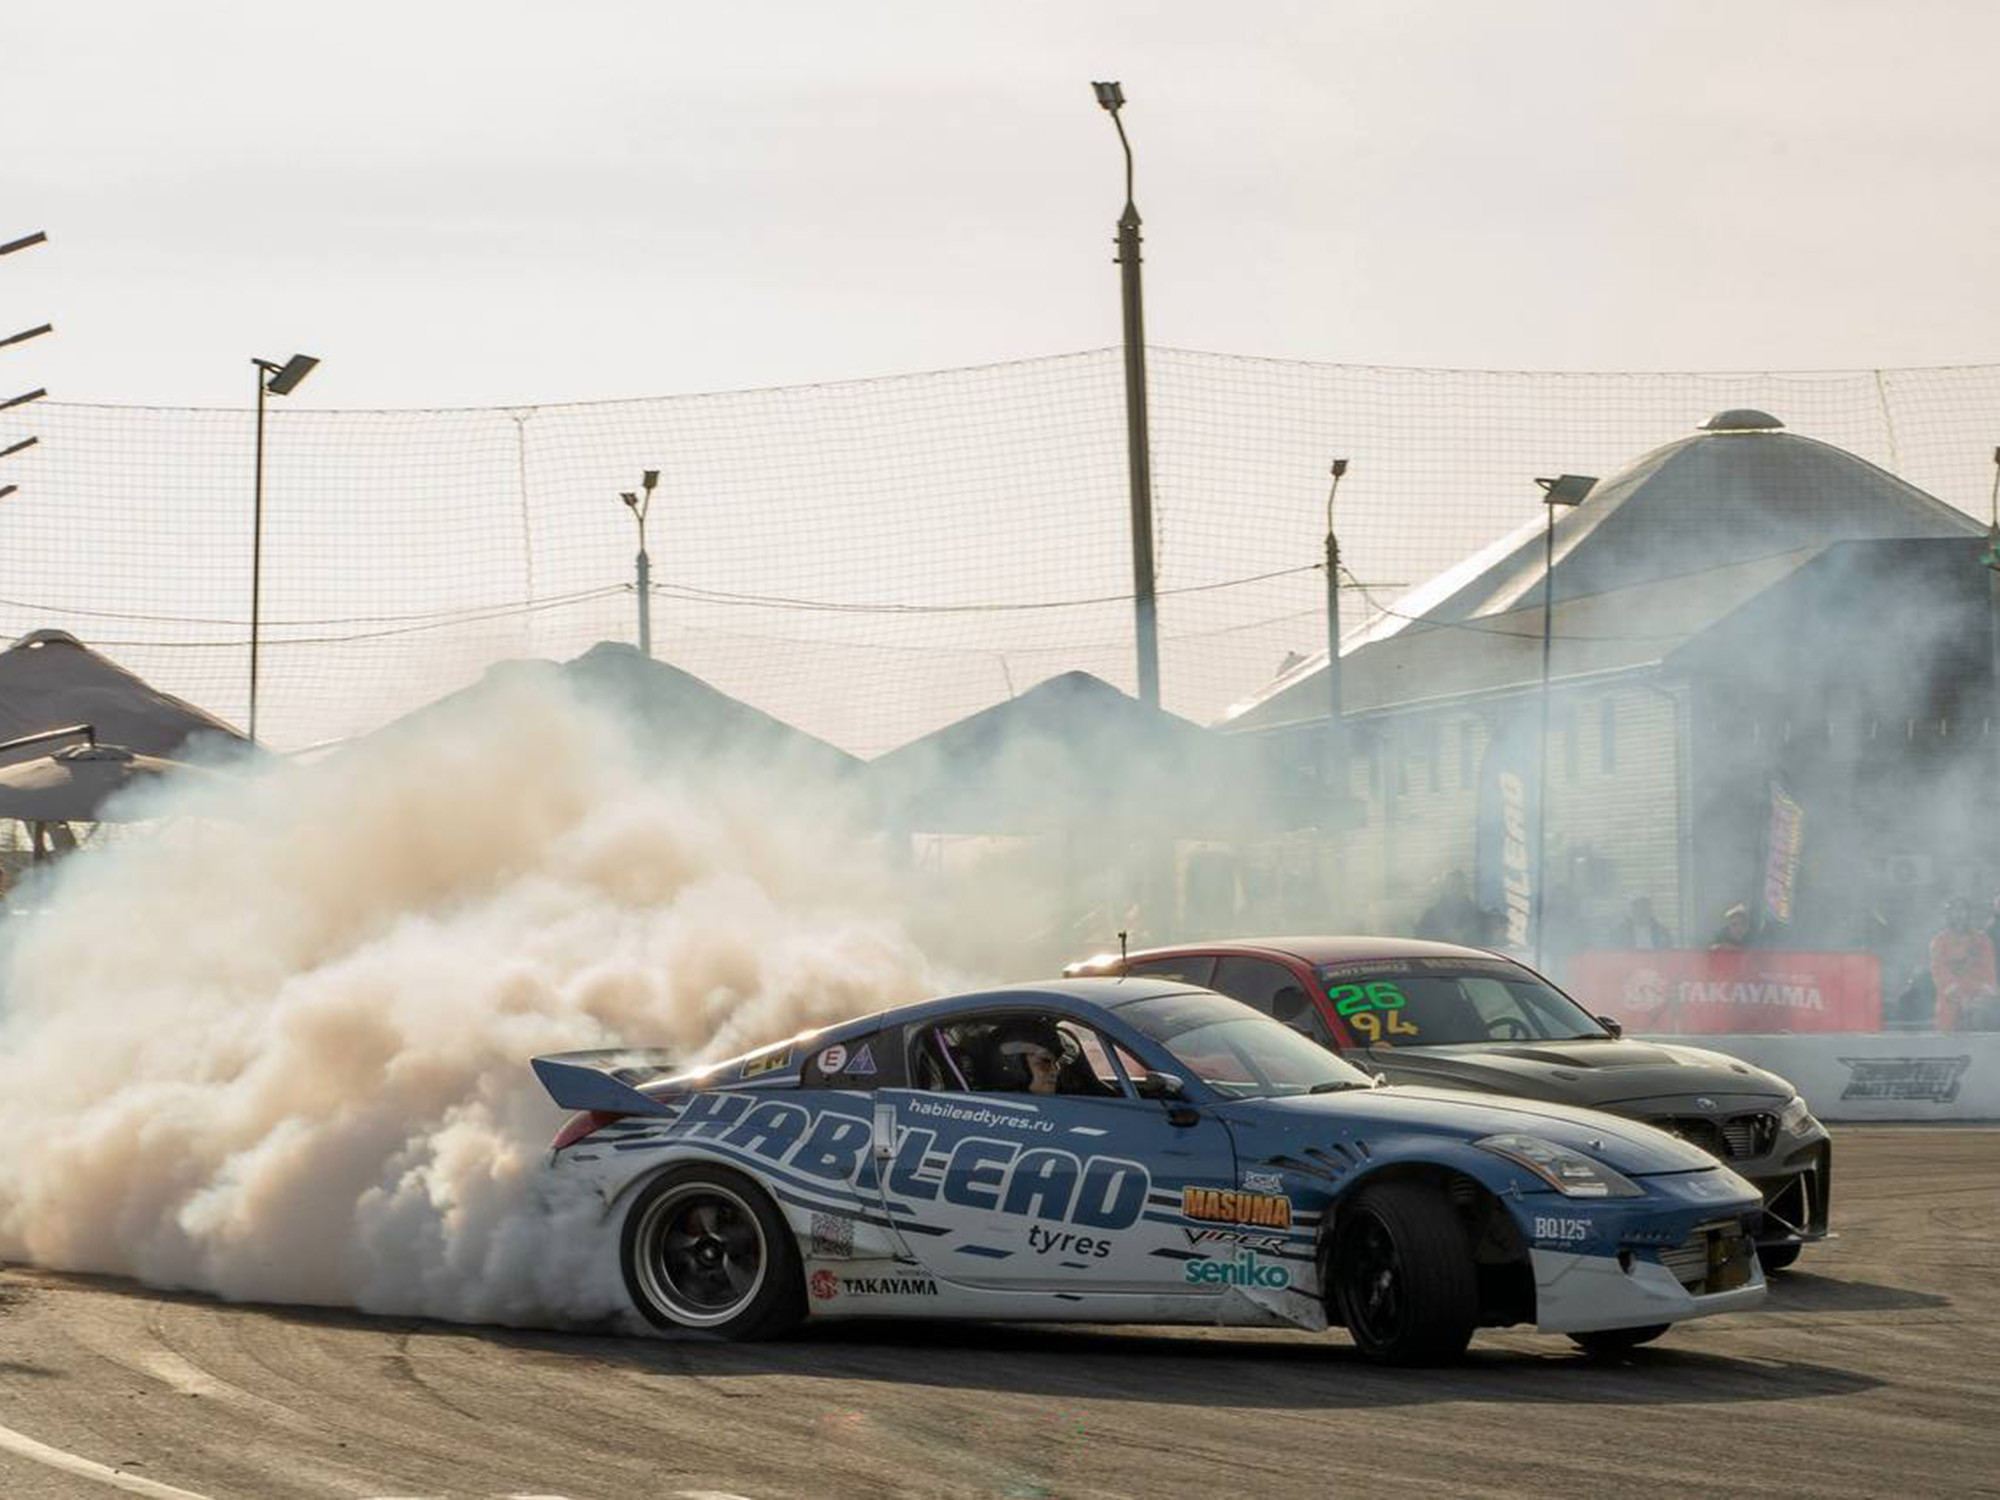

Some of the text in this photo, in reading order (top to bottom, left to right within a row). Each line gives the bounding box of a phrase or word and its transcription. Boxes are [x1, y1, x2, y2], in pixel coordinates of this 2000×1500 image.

[1328, 981, 1406, 1016] 26
[1678, 980, 1823, 1010] TAKAYAMA
[1350, 1010, 1419, 1042] 94
[824, 1050, 841, 1067] E
[908, 1099, 1055, 1132] habileadtyres.ru
[664, 1094, 1151, 1230] HABILEAD
[1184, 1189, 1289, 1226] MASUMA
[1028, 1225, 1112, 1258] tyres
[1184, 1228, 1285, 1255] VIPER
[1184, 1249, 1290, 1289] seniko
[843, 1278, 938, 1296] TAKAYAMA
